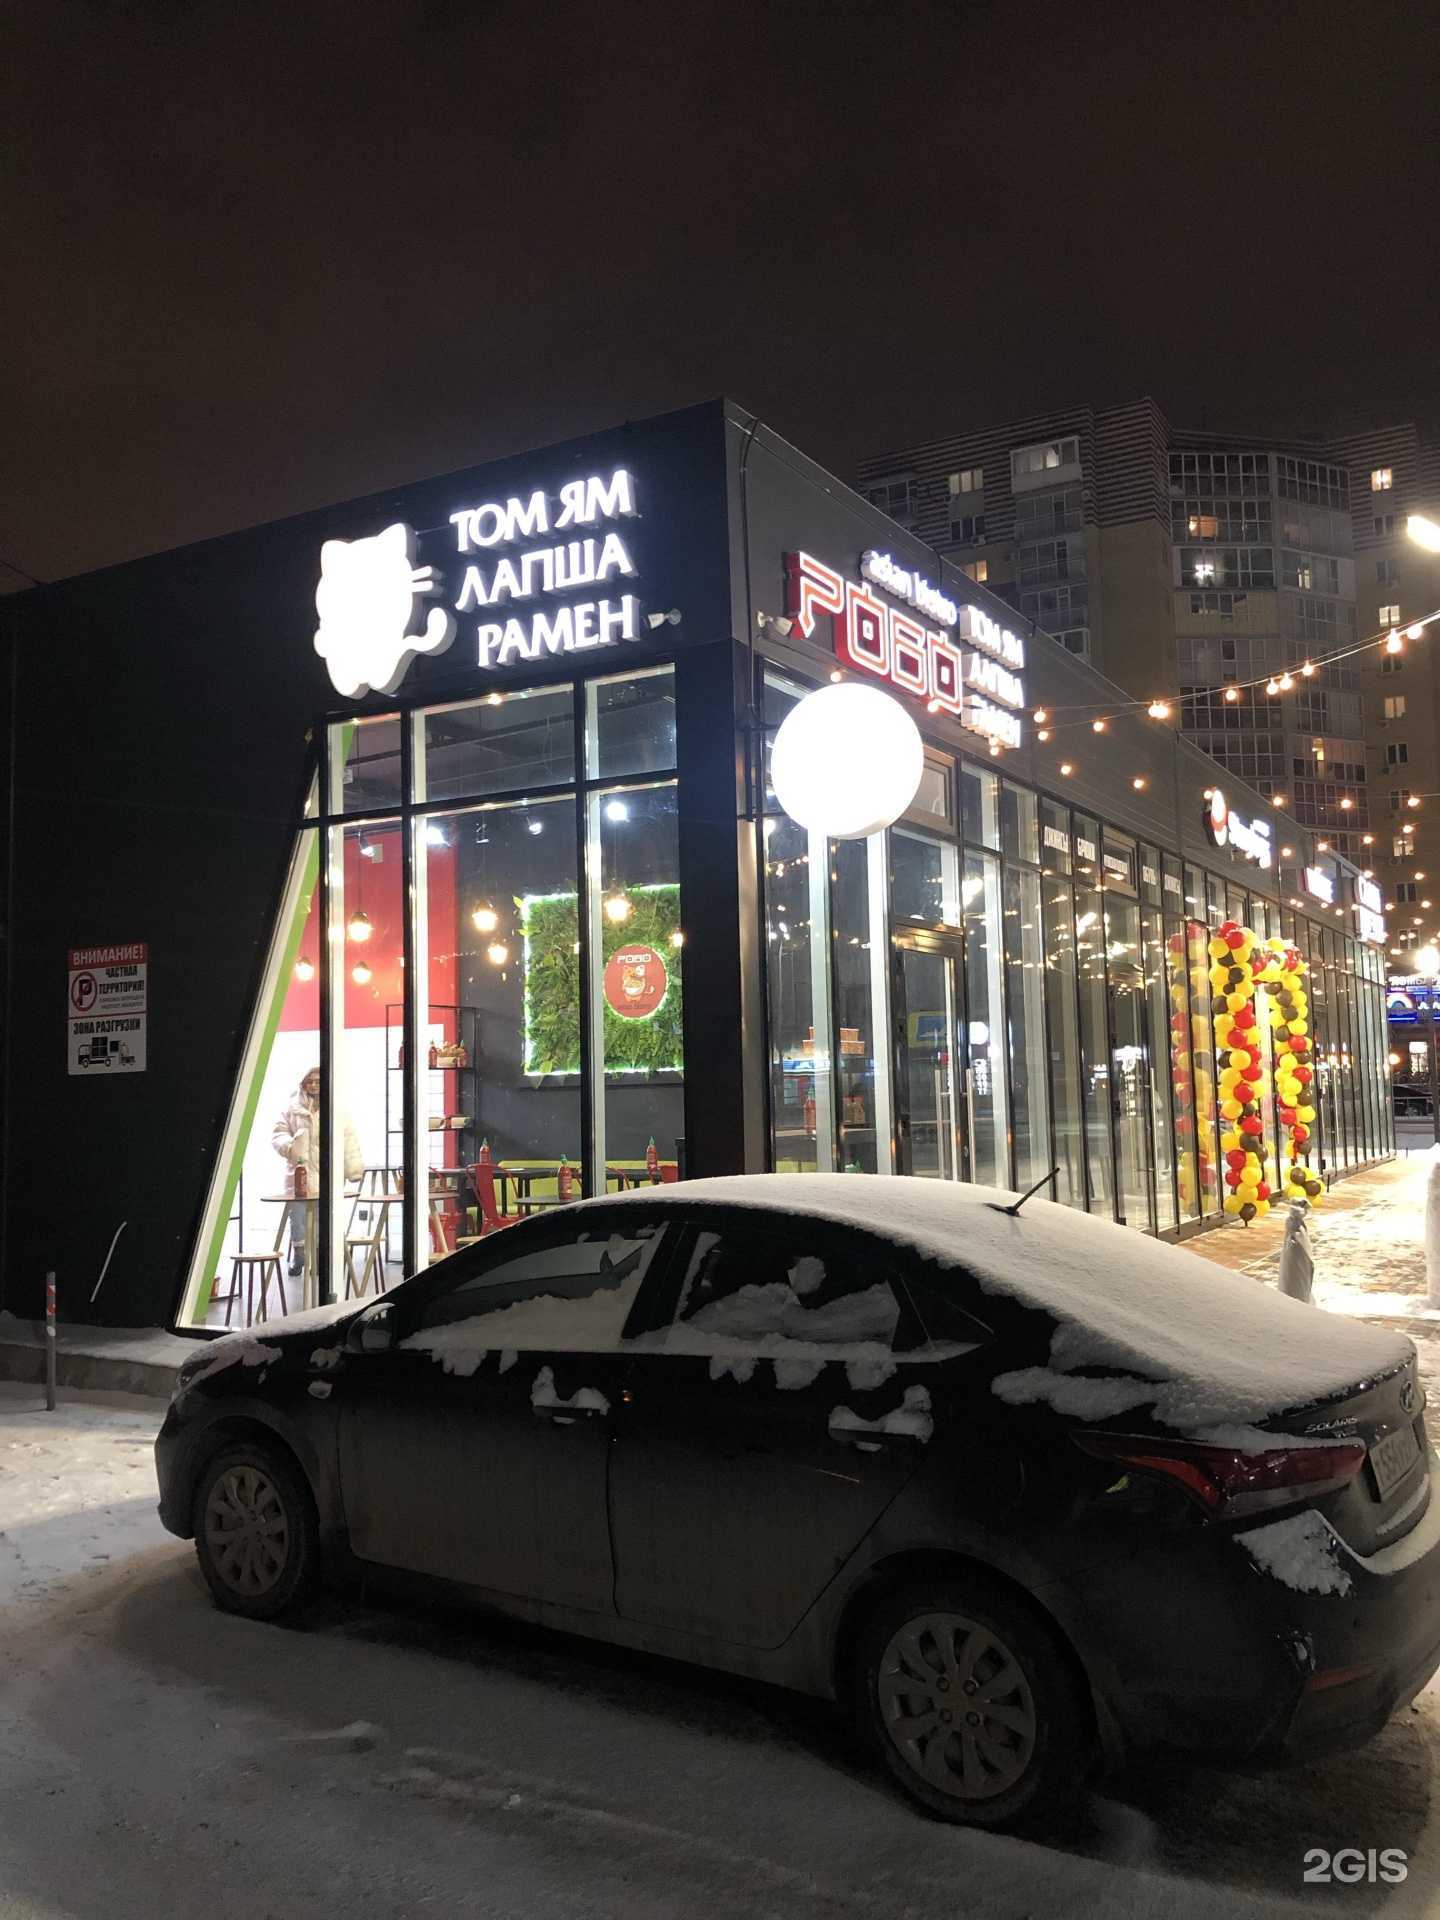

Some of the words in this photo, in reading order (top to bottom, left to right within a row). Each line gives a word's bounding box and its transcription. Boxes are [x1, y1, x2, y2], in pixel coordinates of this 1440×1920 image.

[449, 490, 548, 552] ТОМ
[555, 469, 634, 526] ЯМ
[455, 532, 636, 611] ЛАПША
[477, 594, 638, 667] РАМЕН
[73, 945, 144, 966] ВНИМАНИЕ!
[105, 966, 138, 978] ЧАСТНАЯ
[73, 1022, 95, 1035] ЗОНА
[96, 1018, 141, 1033] РАЗГРУЗКИ
